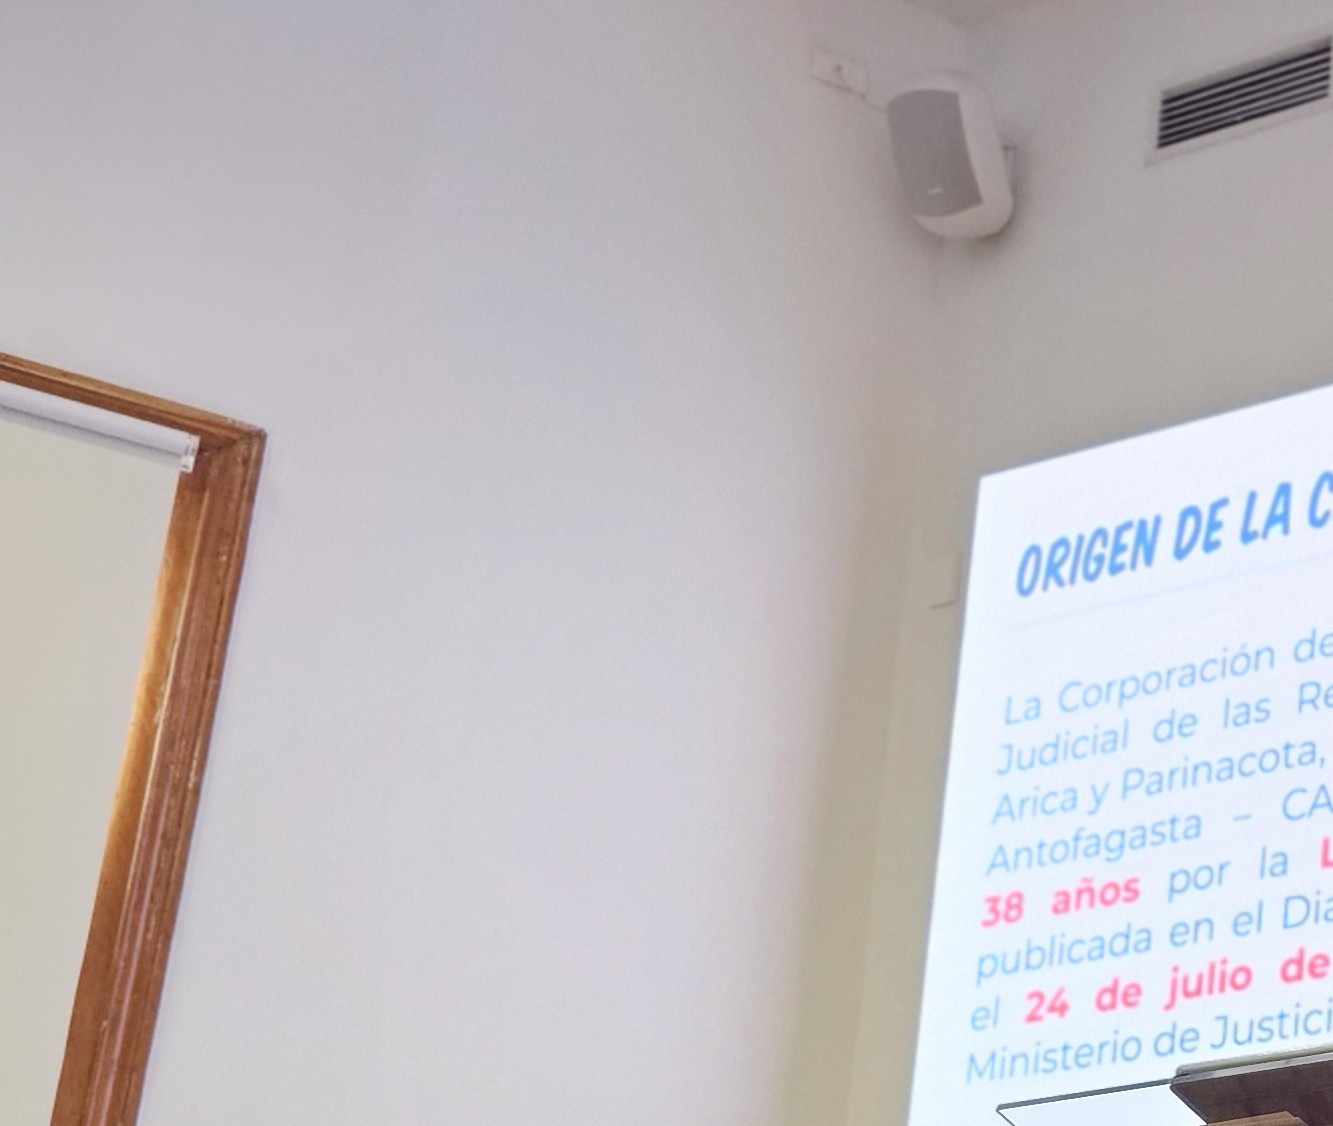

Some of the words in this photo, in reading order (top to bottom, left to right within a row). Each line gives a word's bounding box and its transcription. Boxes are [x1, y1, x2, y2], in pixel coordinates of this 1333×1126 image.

[1016, 514, 1162, 597] ORIGEN
[1172, 497, 1229, 561] DE
[1239, 482, 1292, 546] LA
[1004, 696, 1040, 725] La
[1059, 643, 1274, 712] Corporación
[999, 719, 1129, 775] Judicial
[1154, 709, 1198, 743] de
[1224, 698, 1271, 727] las
[992, 780, 1077, 823] Arica
[1089, 781, 1108, 817] y
[1122, 739, 1324, 798] Parinacota,
[988, 811, 1201, 873] Antofagasta
[982, 892, 1024, 927] 38
[1052, 877, 1140, 915] años
[1168, 861, 1229, 902] por
[1260, 846, 1289, 878] la
[977, 920, 1151, 985] publicada
[1170, 918, 1213, 947] en
[1232, 901, 1263, 936] el
[971, 996, 1000, 1031] el
[1025, 988, 1069, 1023] 24
[1095, 977, 1142, 1012] de
[1163, 958, 1252, 1011] julio
[1280, 947, 1330, 984] de
[968, 1030, 1141, 1081] Ministerio
[1154, 1022, 1199, 1057] de
